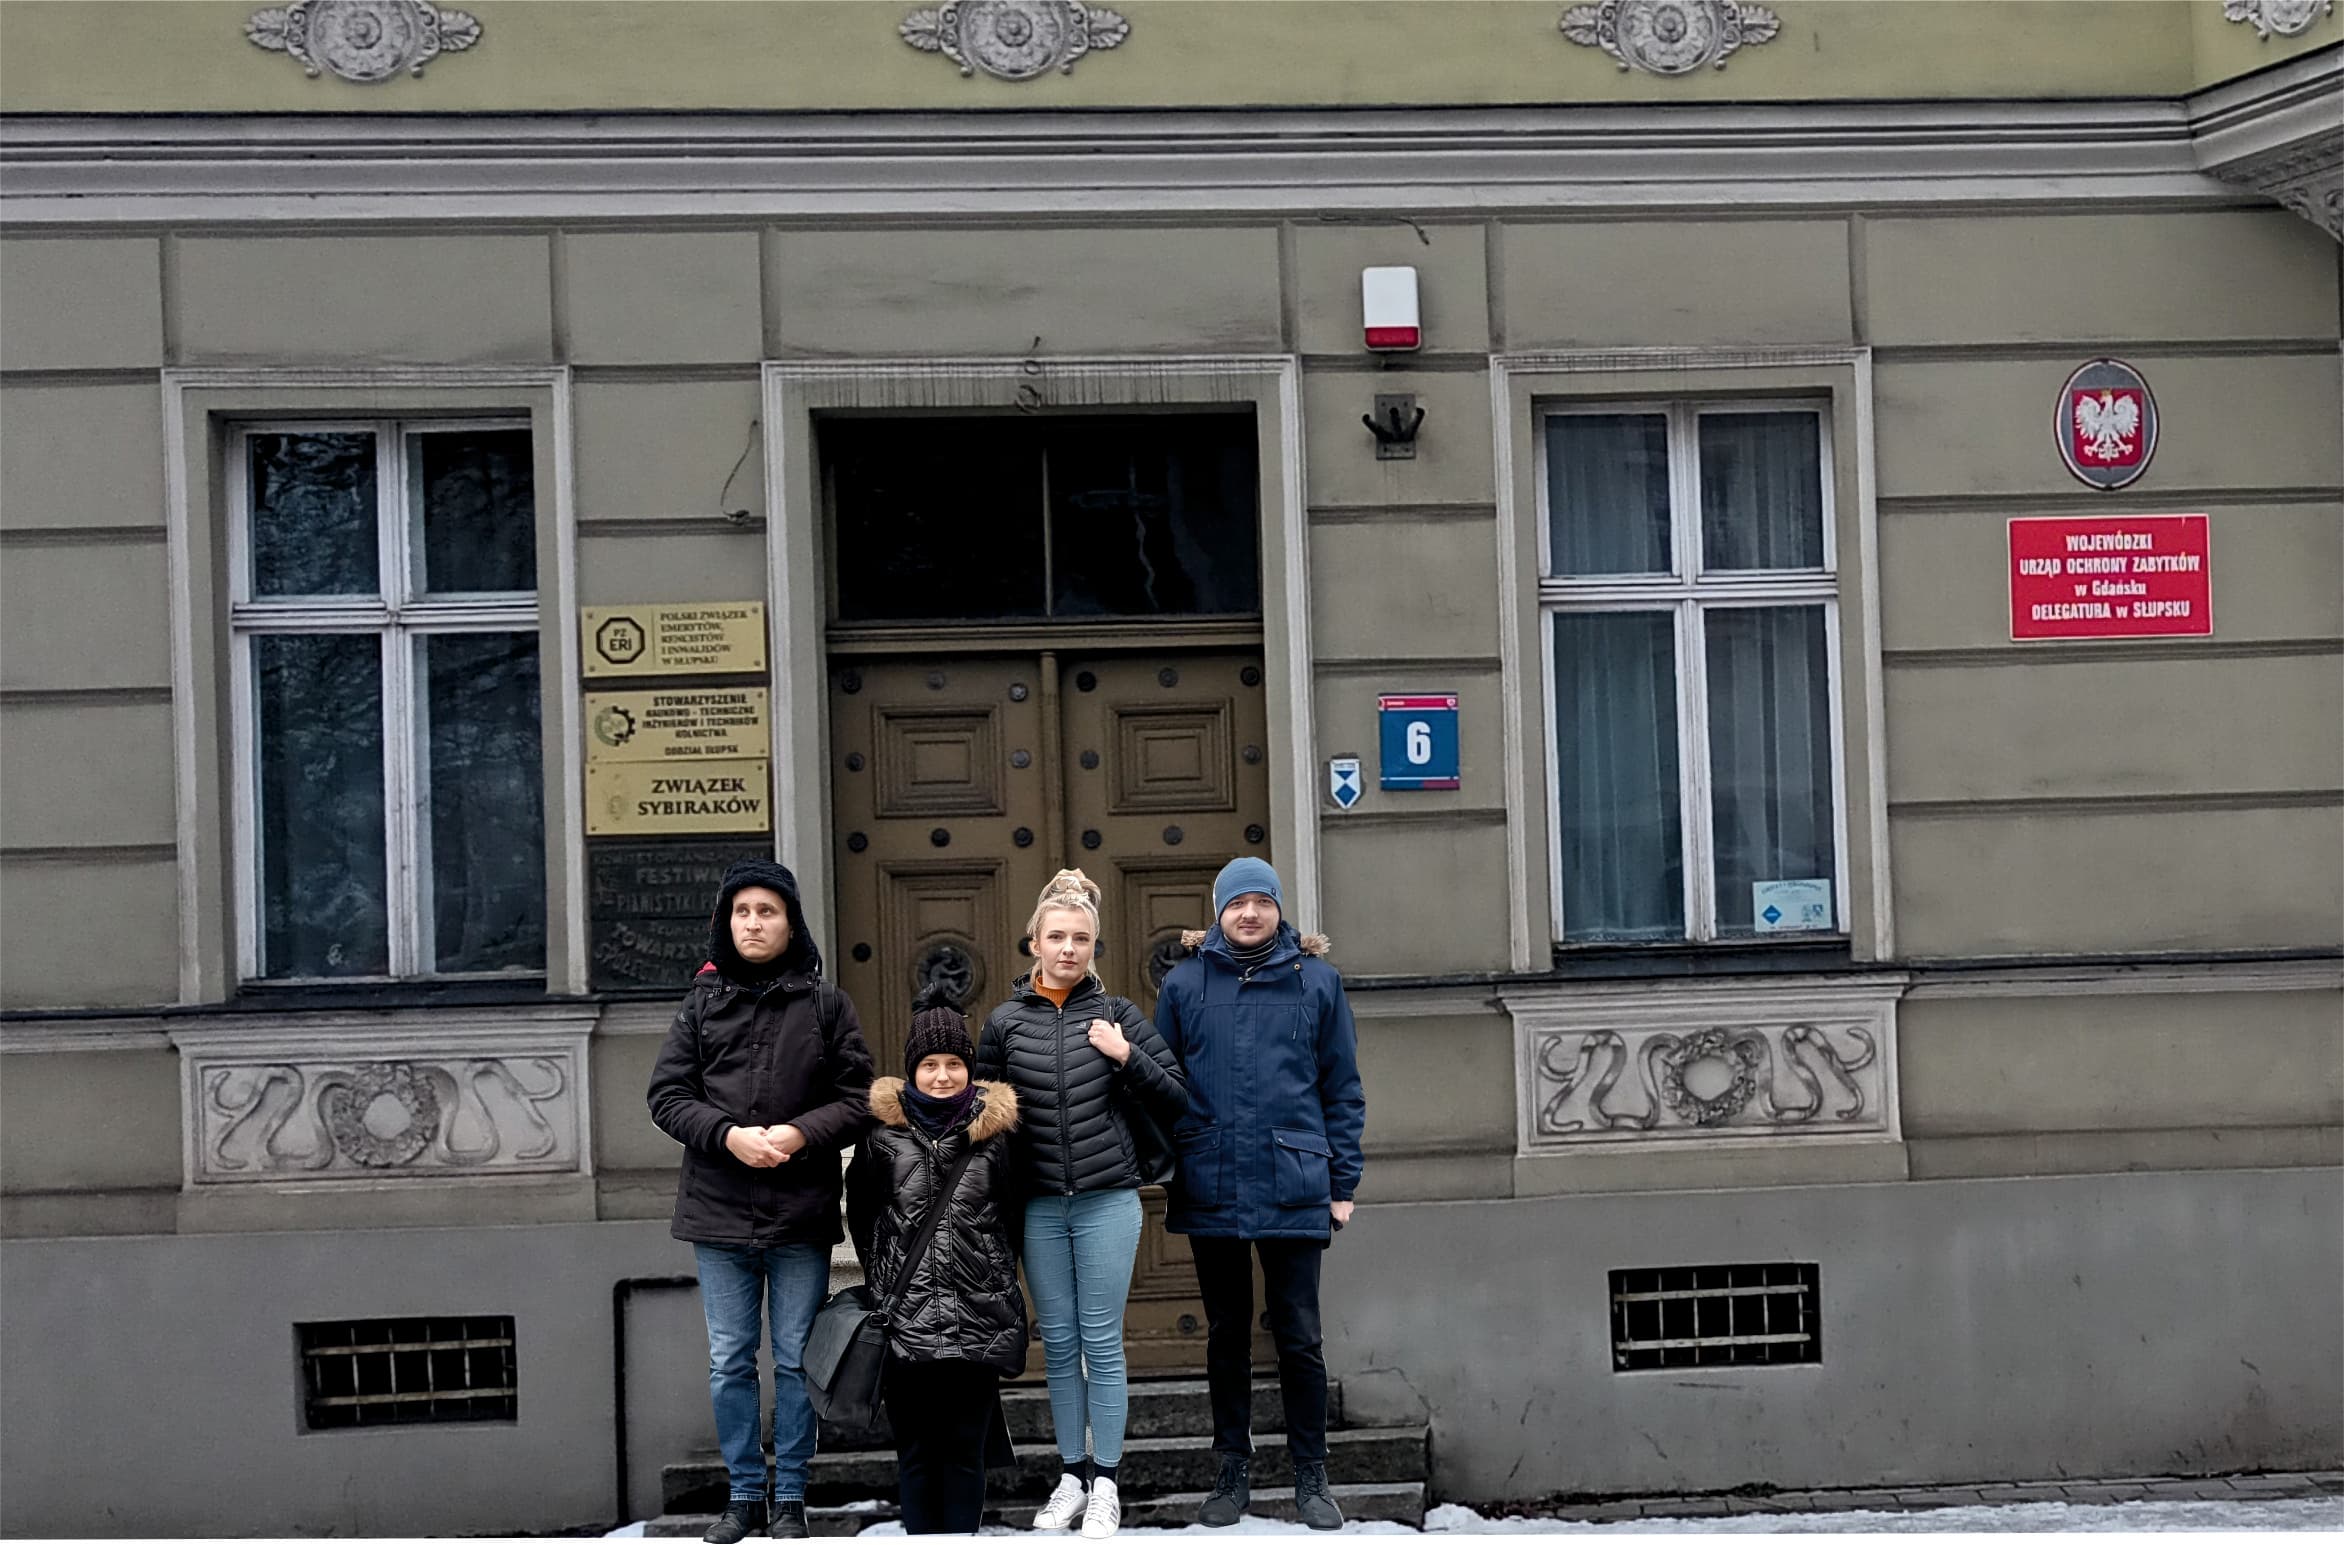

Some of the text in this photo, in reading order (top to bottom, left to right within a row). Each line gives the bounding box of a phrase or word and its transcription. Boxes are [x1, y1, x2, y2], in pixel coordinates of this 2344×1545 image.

[2066, 530, 2152, 552] WOJEWÓDZKI
[2020, 552, 2200, 578] URZĄD OCHRONY ZABYTKÓW
[2074, 580, 2146, 596] w Gdańsku
[660, 610, 747, 620] POLSKI ZWIĄZEK
[2032, 601, 2190, 620] DELEGATURA w SŁUPSKU
[613, 628, 626, 637] PZ
[609, 639, 632, 652] ERI
[653, 694, 747, 706] STOWARZYSZENIE
[700, 706, 755, 716] TECHNICZNE
[1407, 721, 1431, 764] 6
[651, 778, 745, 796] ZWIĄZEK
[638, 799, 761, 816] SYBIRAKÓW
[636, 867, 721, 884] FESTIWA
